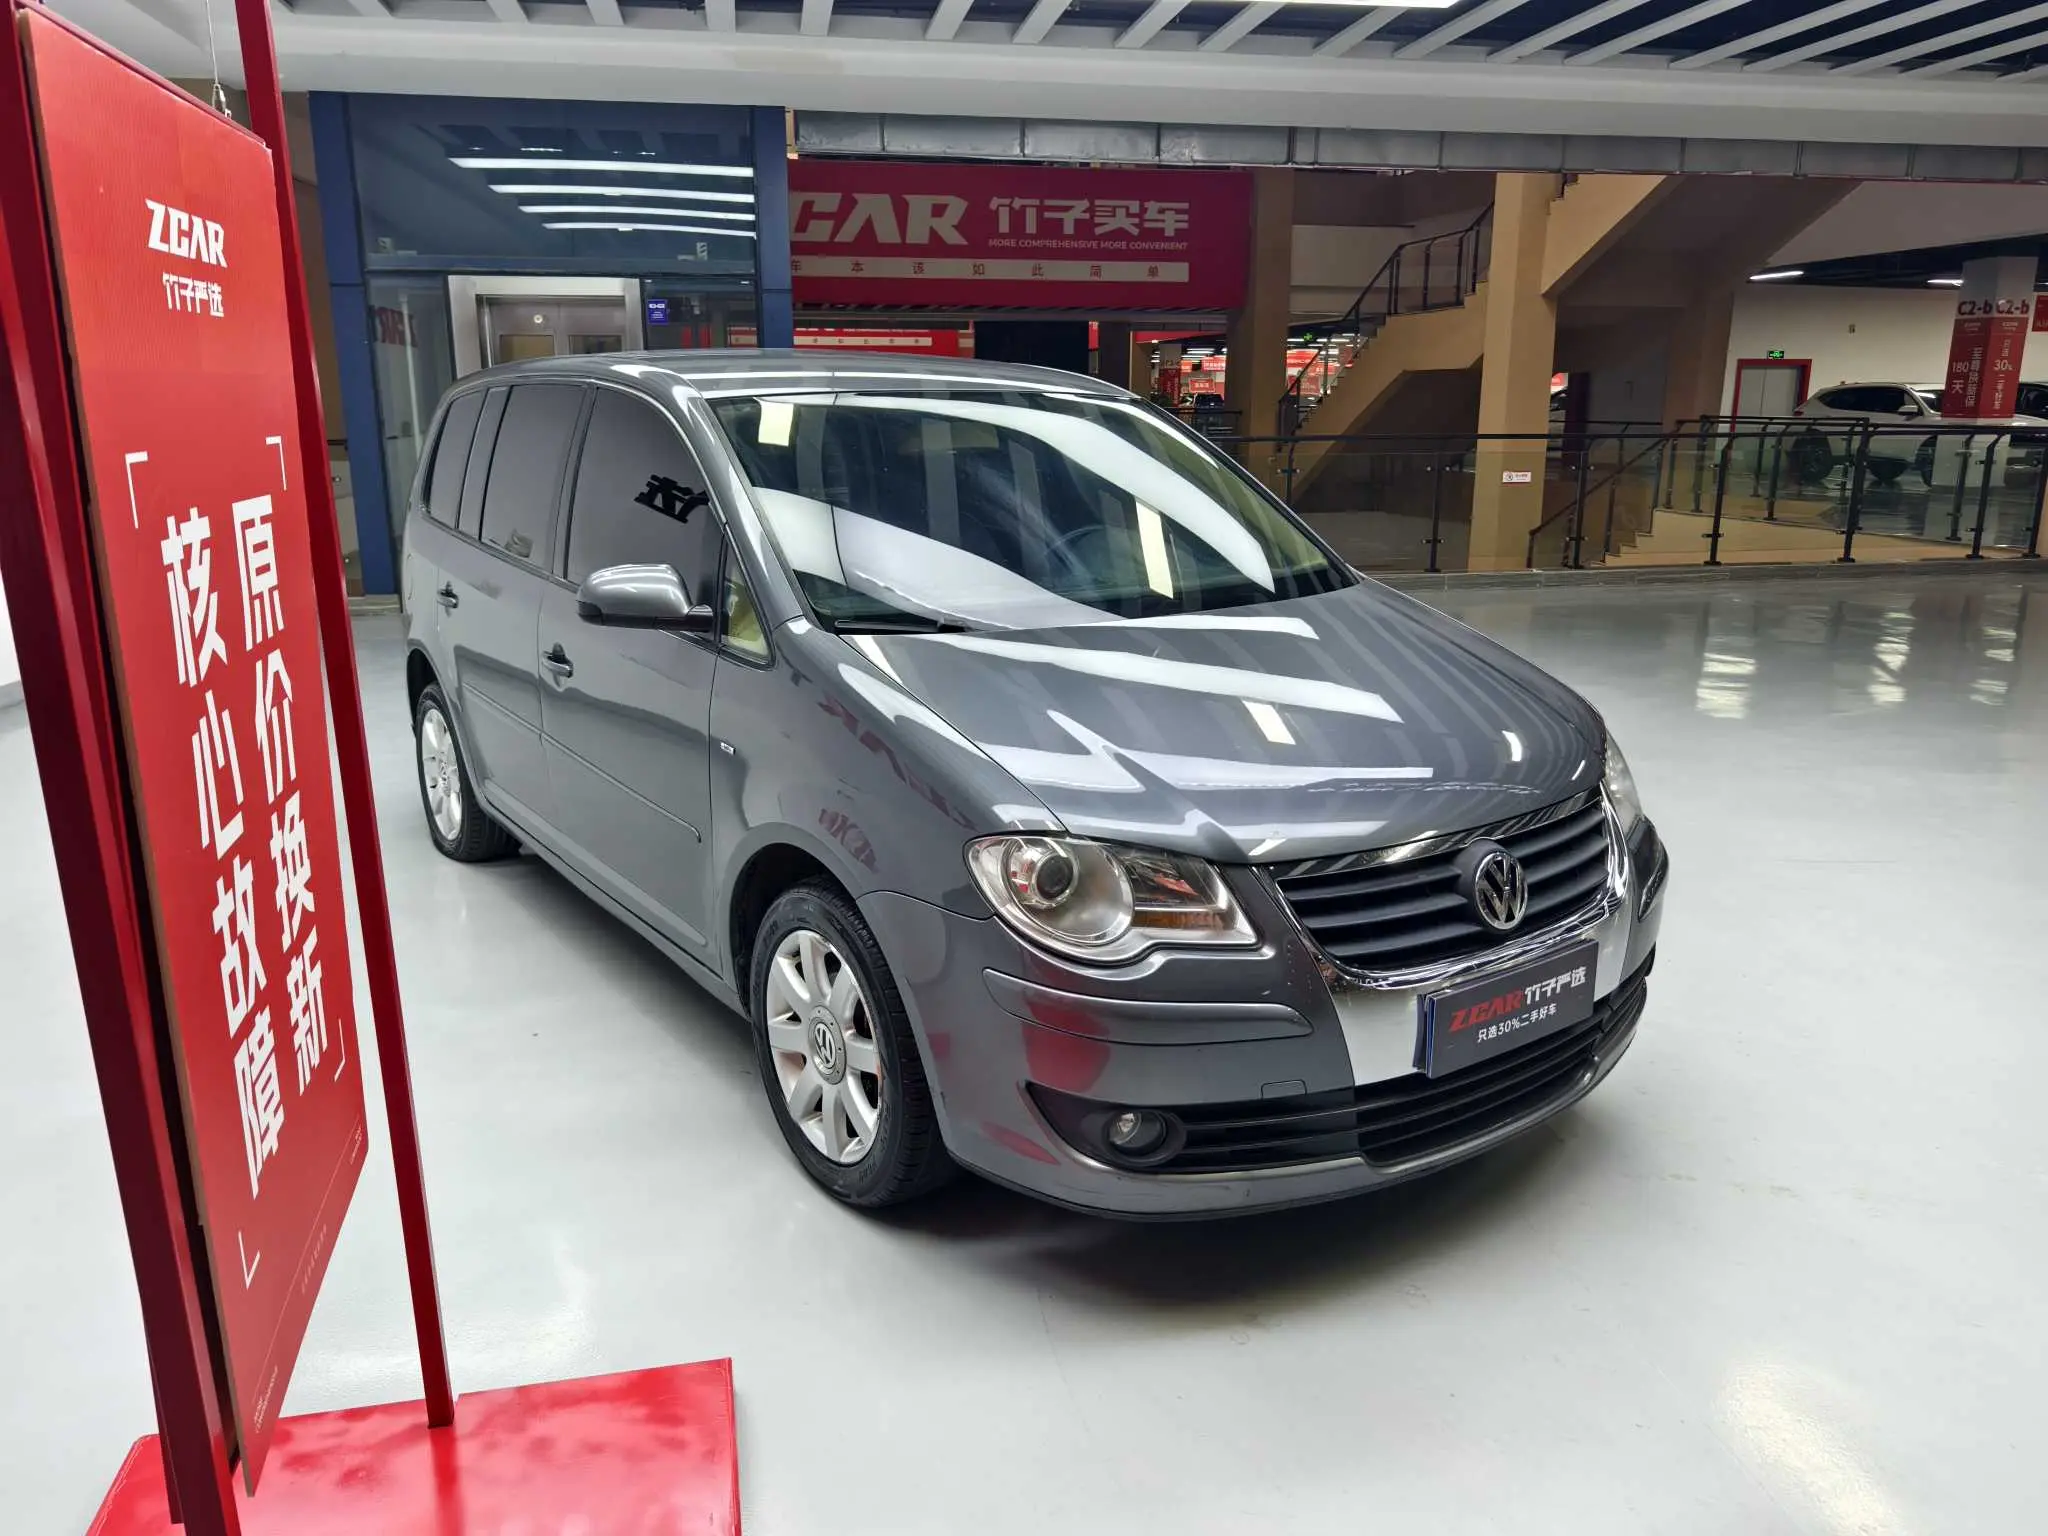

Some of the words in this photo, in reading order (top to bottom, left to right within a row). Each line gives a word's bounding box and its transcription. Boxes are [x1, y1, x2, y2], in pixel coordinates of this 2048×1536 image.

[145, 198, 228, 268] ZCAR
[989, 196, 1190, 237] 竹子买车
[988, 238, 1017, 248] MORE
[1018, 239, 1098, 249] COMPREHENSIVE
[1100, 240, 1127, 250] MORE
[1129, 242, 1189, 252] CONVENIENT
[162, 271, 225, 318] 竹子严选
[1958, 299, 1993, 316] C2-b
[1951, 379, 1965, 394] 天
[1952, 361, 1969, 373] 180
[232, 494, 328, 1096] 原价换新
[161, 507, 285, 1199] 核心故障
[1450, 988, 1524, 1032] ZCAR
[1524, 966, 1587, 1005] 竹子严选
[1477, 1003, 1558, 1043] 只选30%二手好车
